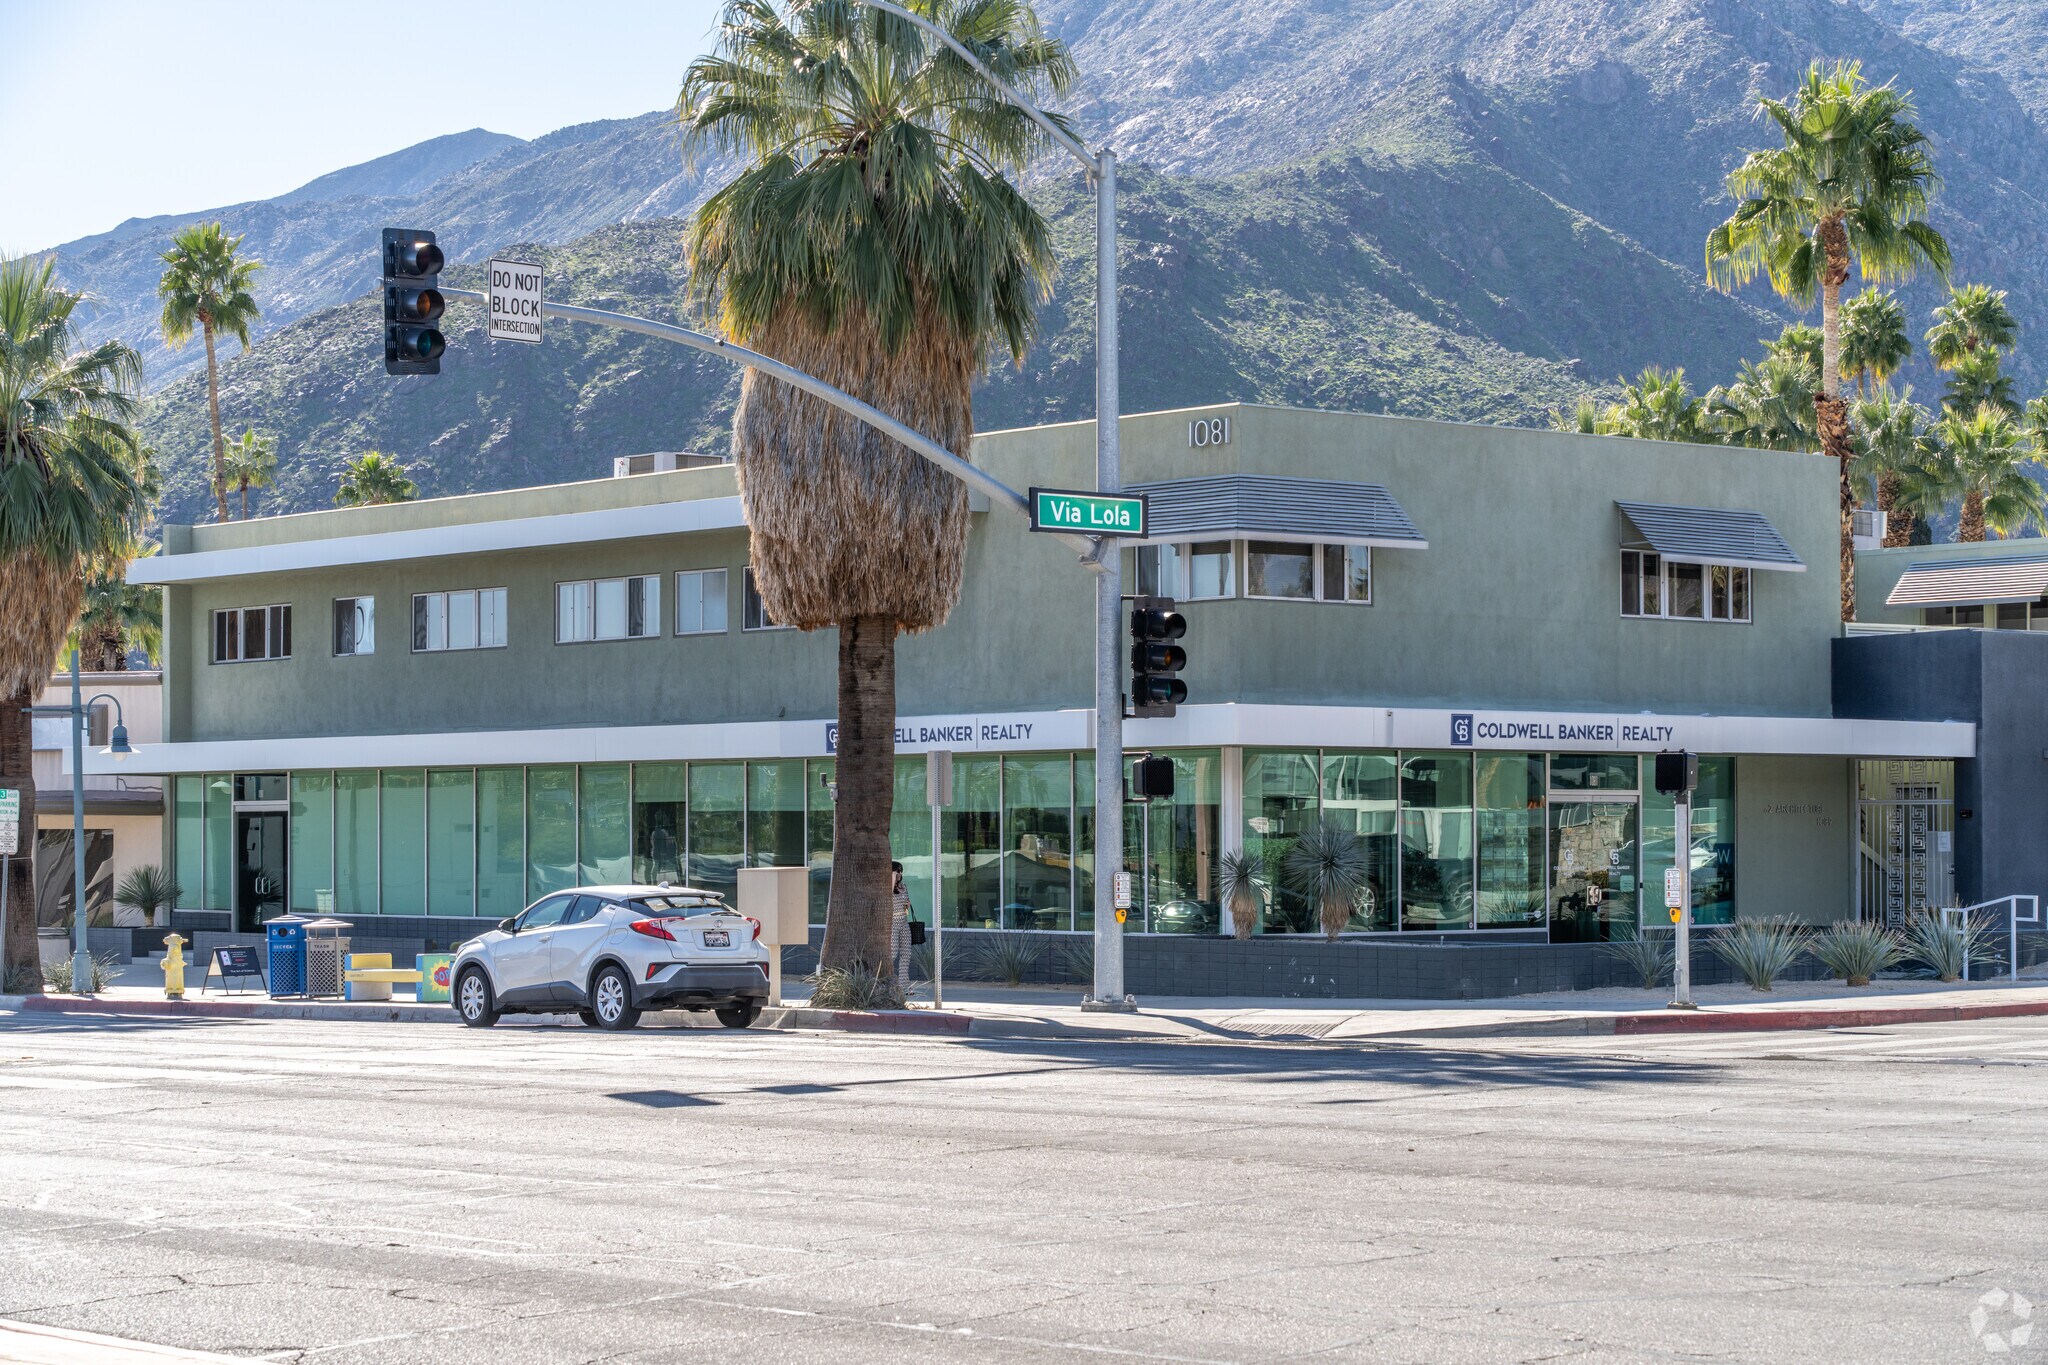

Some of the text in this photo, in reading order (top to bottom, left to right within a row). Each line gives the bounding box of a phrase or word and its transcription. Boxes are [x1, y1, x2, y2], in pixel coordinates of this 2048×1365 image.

[493, 270, 541, 292] DO NOT
[492, 295, 540, 318] BLOCK
[491, 318, 541, 335] INTERSECTION
[1188, 417, 1231, 447] 1081
[1050, 500, 1130, 526] Via Lola
[919, 726, 974, 743] BANKER
[981, 724, 1033, 741] REALTY
[1477, 722, 1554, 740] COLDWELL
[1558, 724, 1614, 741] BANKER
[1622, 725, 1674, 741] REALTY
